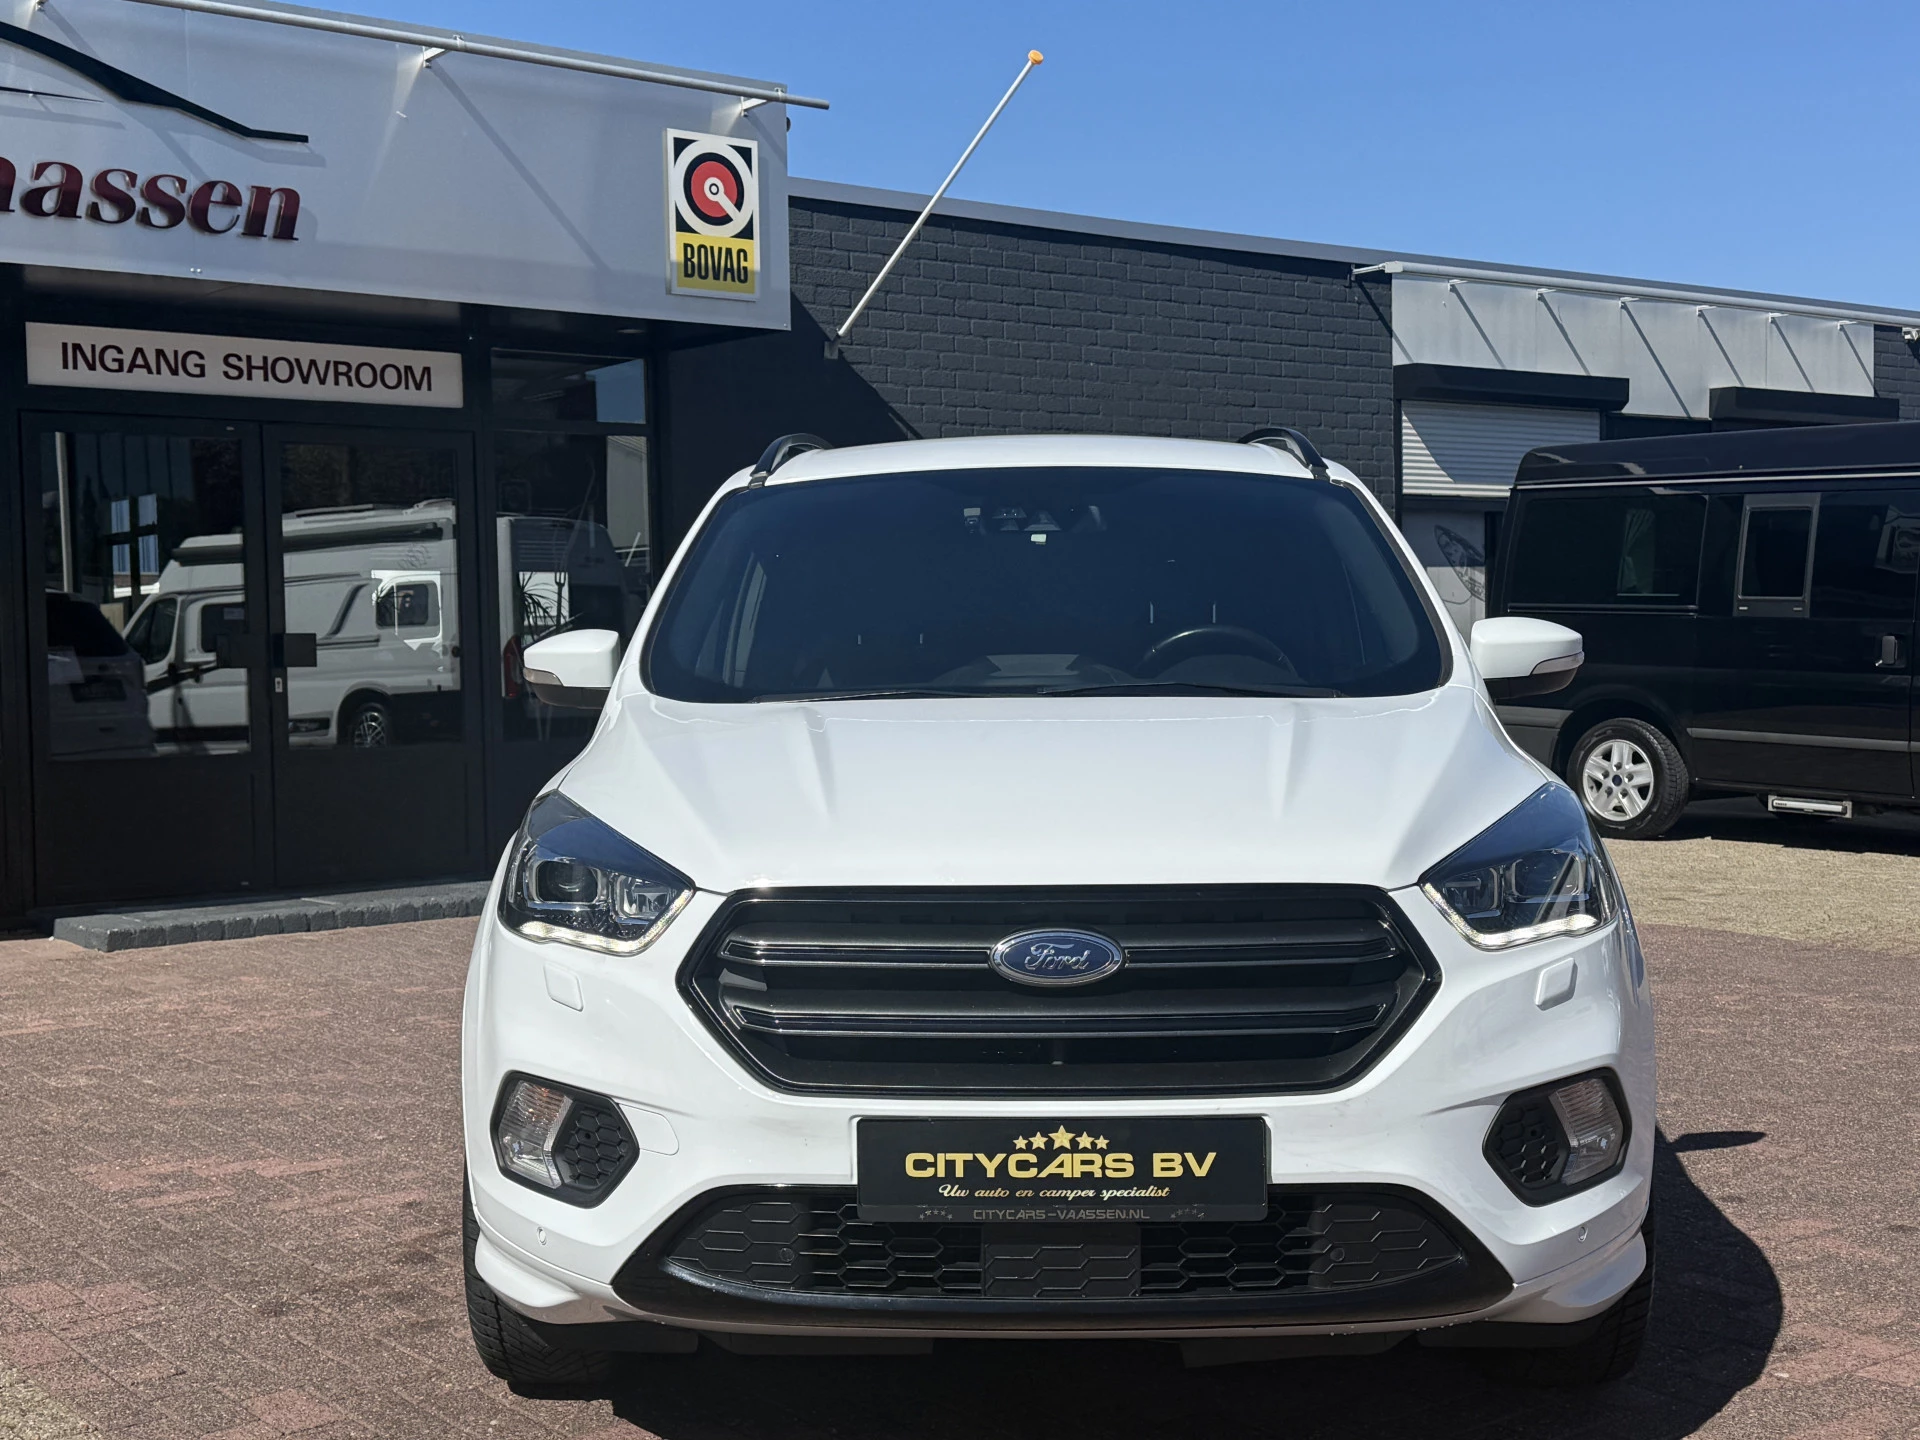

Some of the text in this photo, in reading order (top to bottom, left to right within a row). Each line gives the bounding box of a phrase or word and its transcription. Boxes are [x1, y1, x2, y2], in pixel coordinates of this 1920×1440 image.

[0, 156, 300, 241] assen
[683, 243, 748, 284] BOVAG
[61, 342, 432, 392] INGANG SHOWROOM
[1025, 943, 1091, 970] Ford
[905, 1151, 1217, 1179] CITYCARS BV
[938, 1184, 1171, 1201] Uw auto en camper specialist
[973, 1209, 1151, 1220] CITYCARS-VAASSEN.NL
